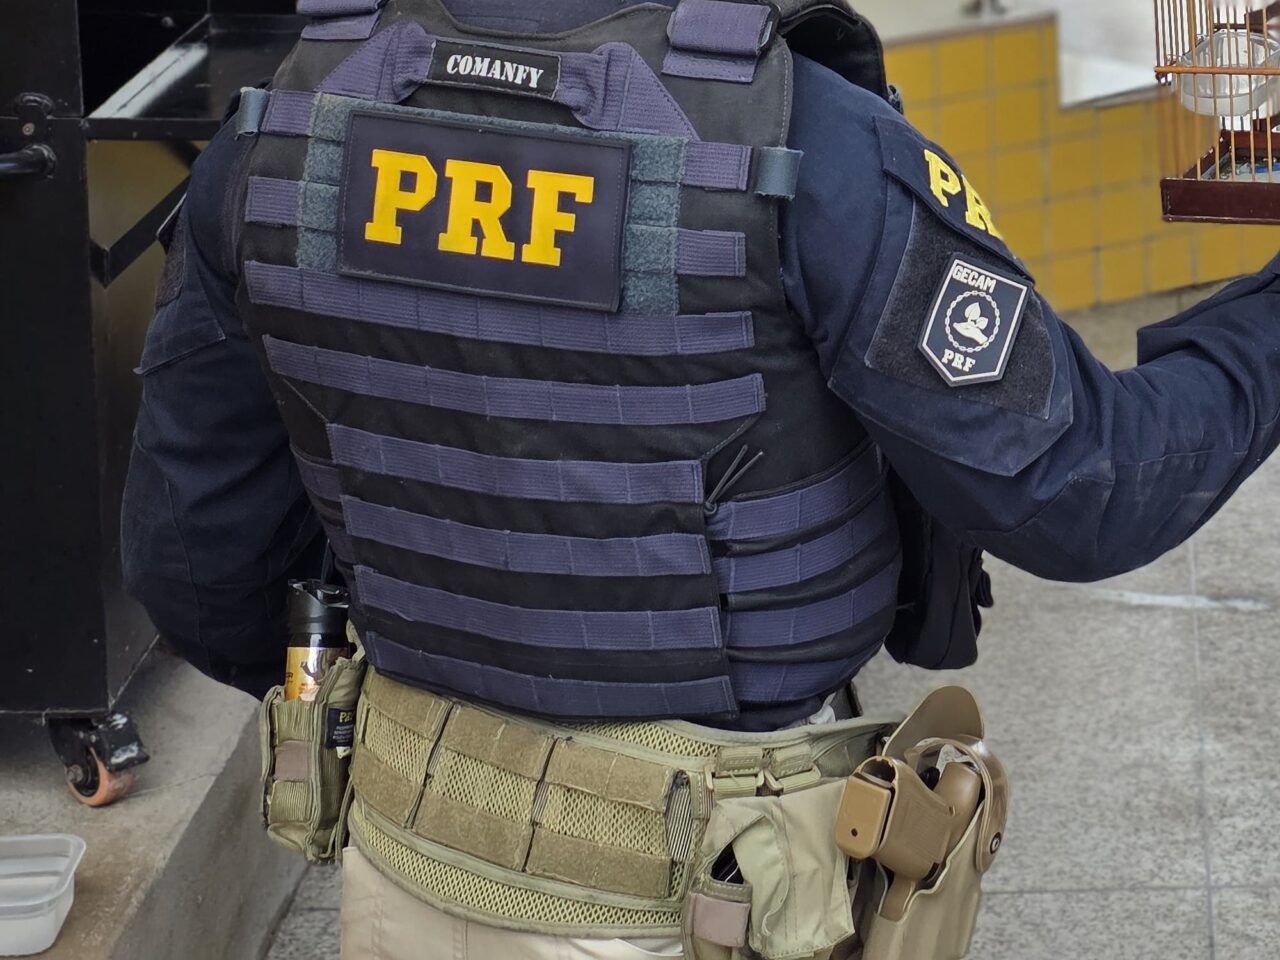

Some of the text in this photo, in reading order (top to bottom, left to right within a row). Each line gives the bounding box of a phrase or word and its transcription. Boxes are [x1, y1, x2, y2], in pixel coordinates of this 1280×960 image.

[446, 54, 544, 88] COMANFY
[364, 149, 594, 266] PRF
[952, 265, 997, 293] GECAM
[941, 348, 976, 372] PRF
